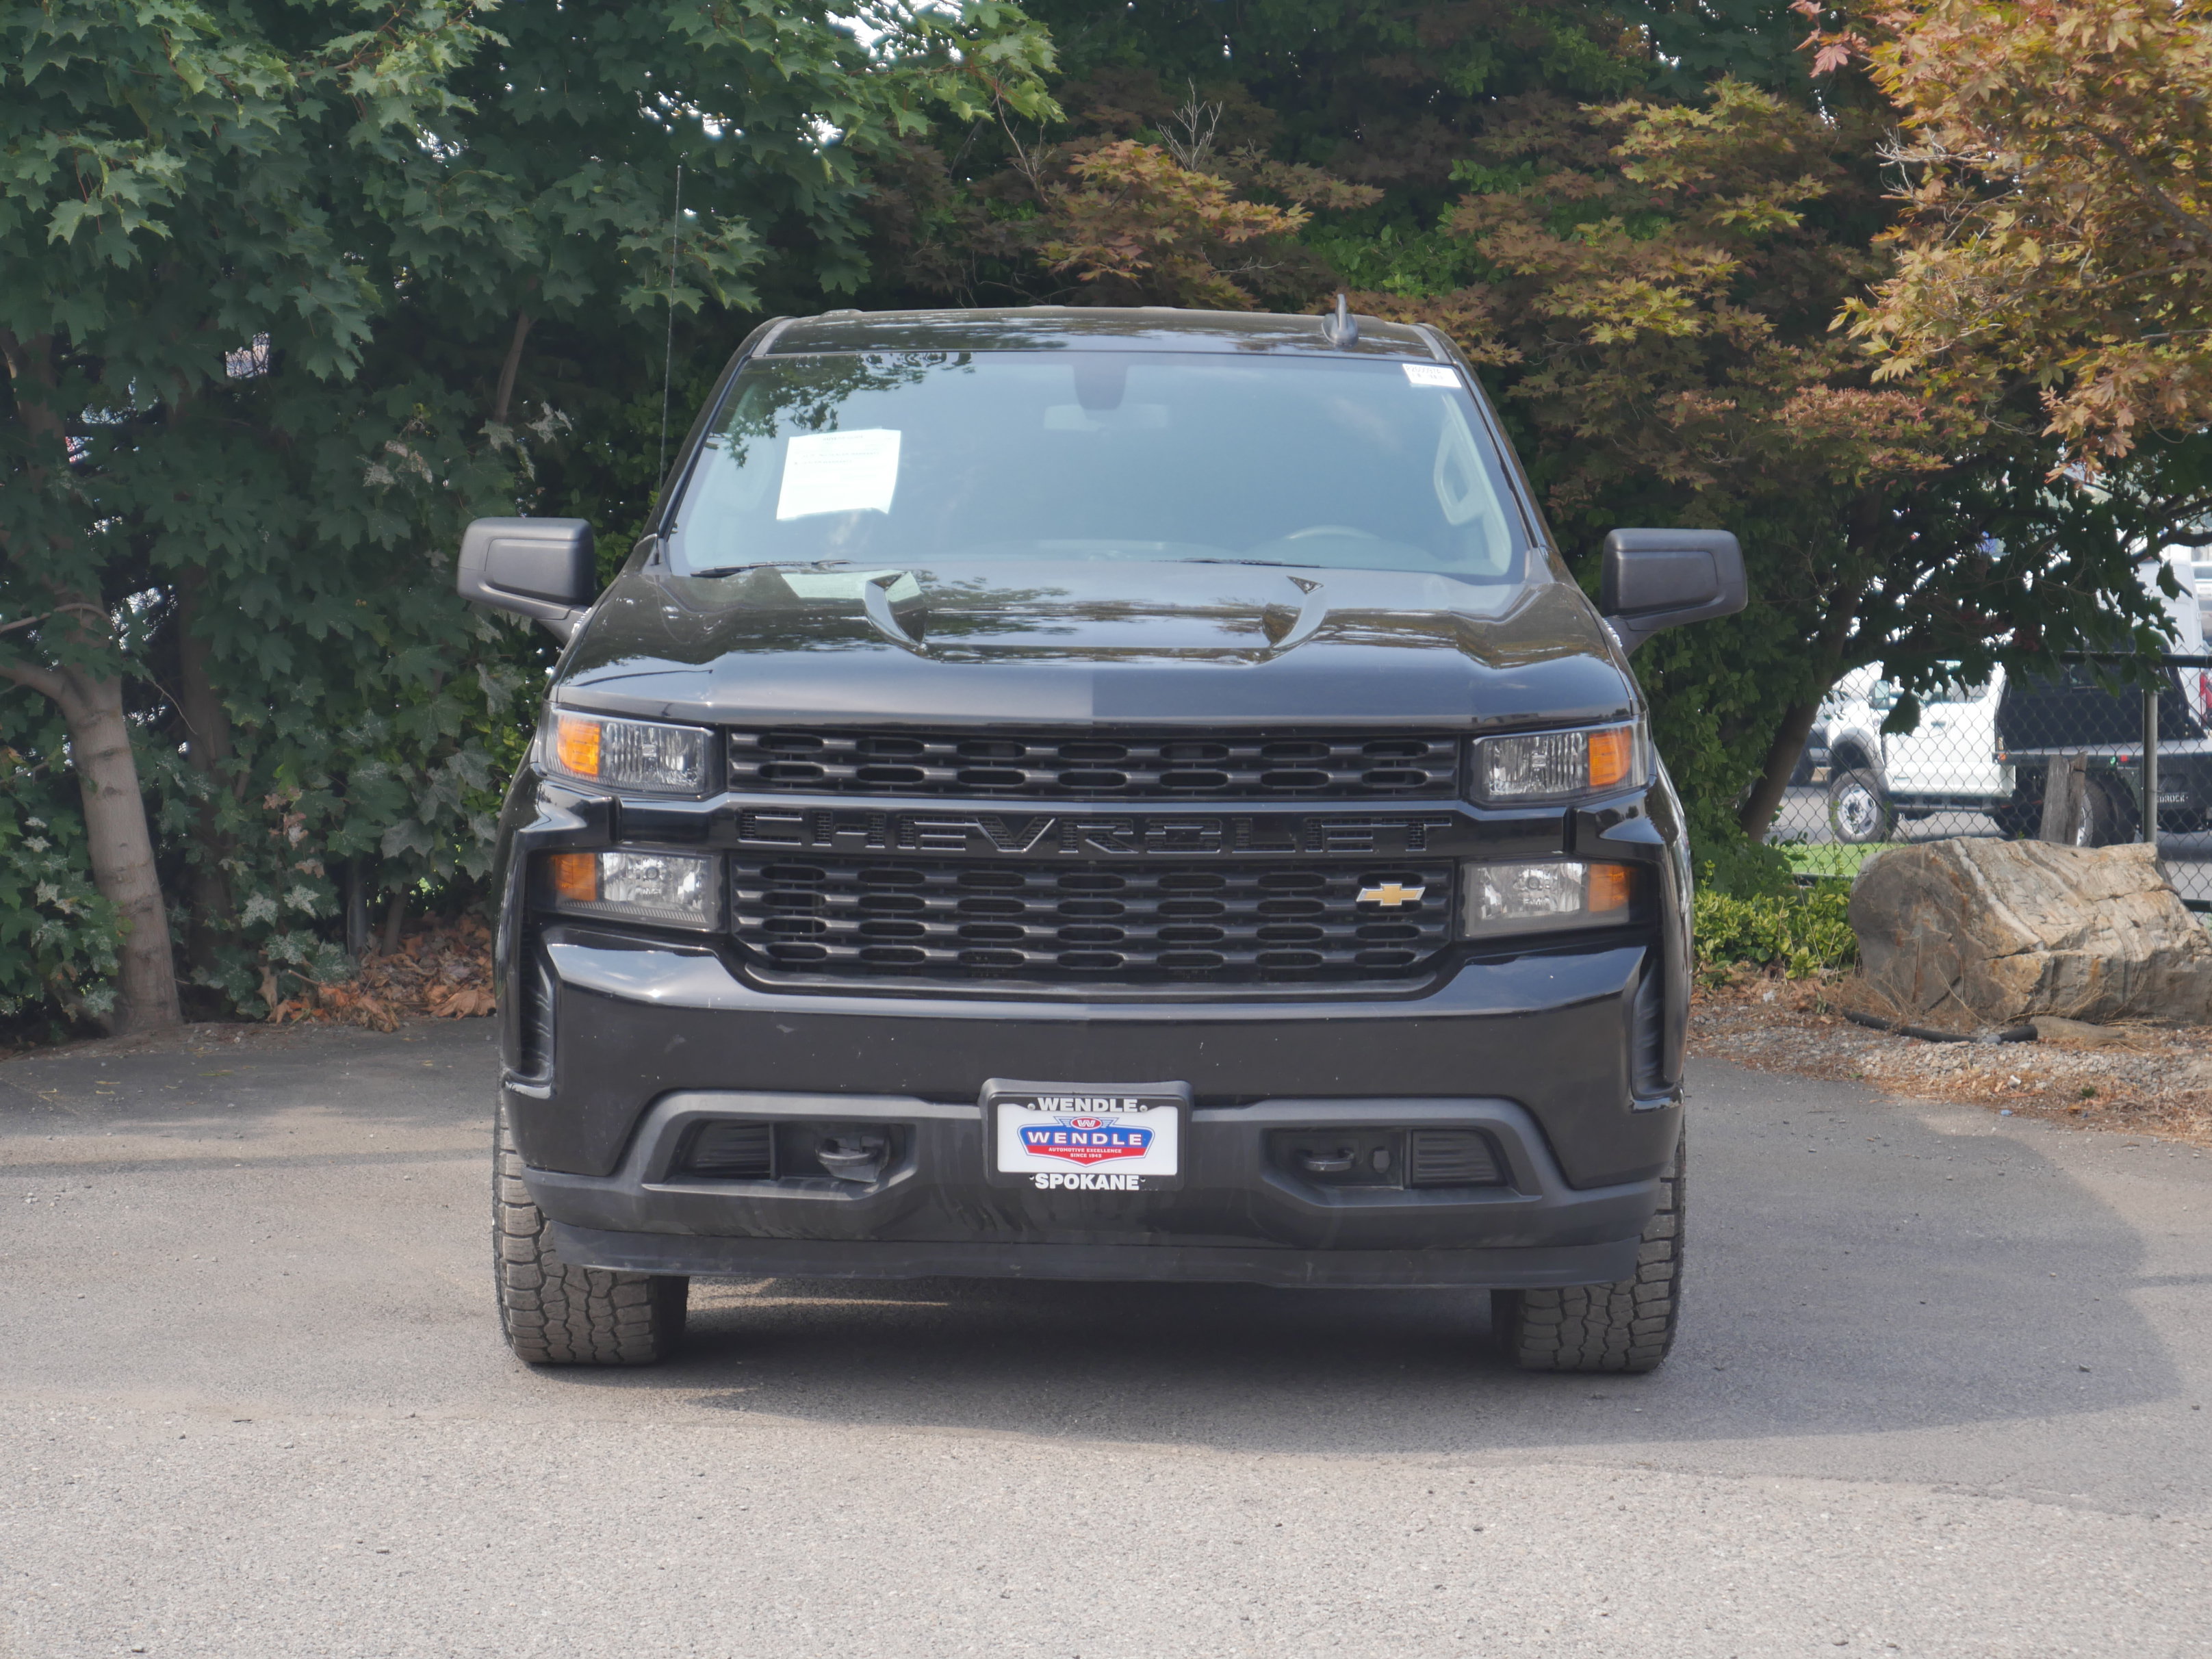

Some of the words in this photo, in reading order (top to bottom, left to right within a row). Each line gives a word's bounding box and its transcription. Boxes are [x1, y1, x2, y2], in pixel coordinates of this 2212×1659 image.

[737, 810, 1452, 853] CHEVROLET
[1038, 1097, 1138, 1112] WENDLE
[1028, 1131, 1142, 1145] WENDLE
[1035, 1173, 1140, 1190] SPOKANE
